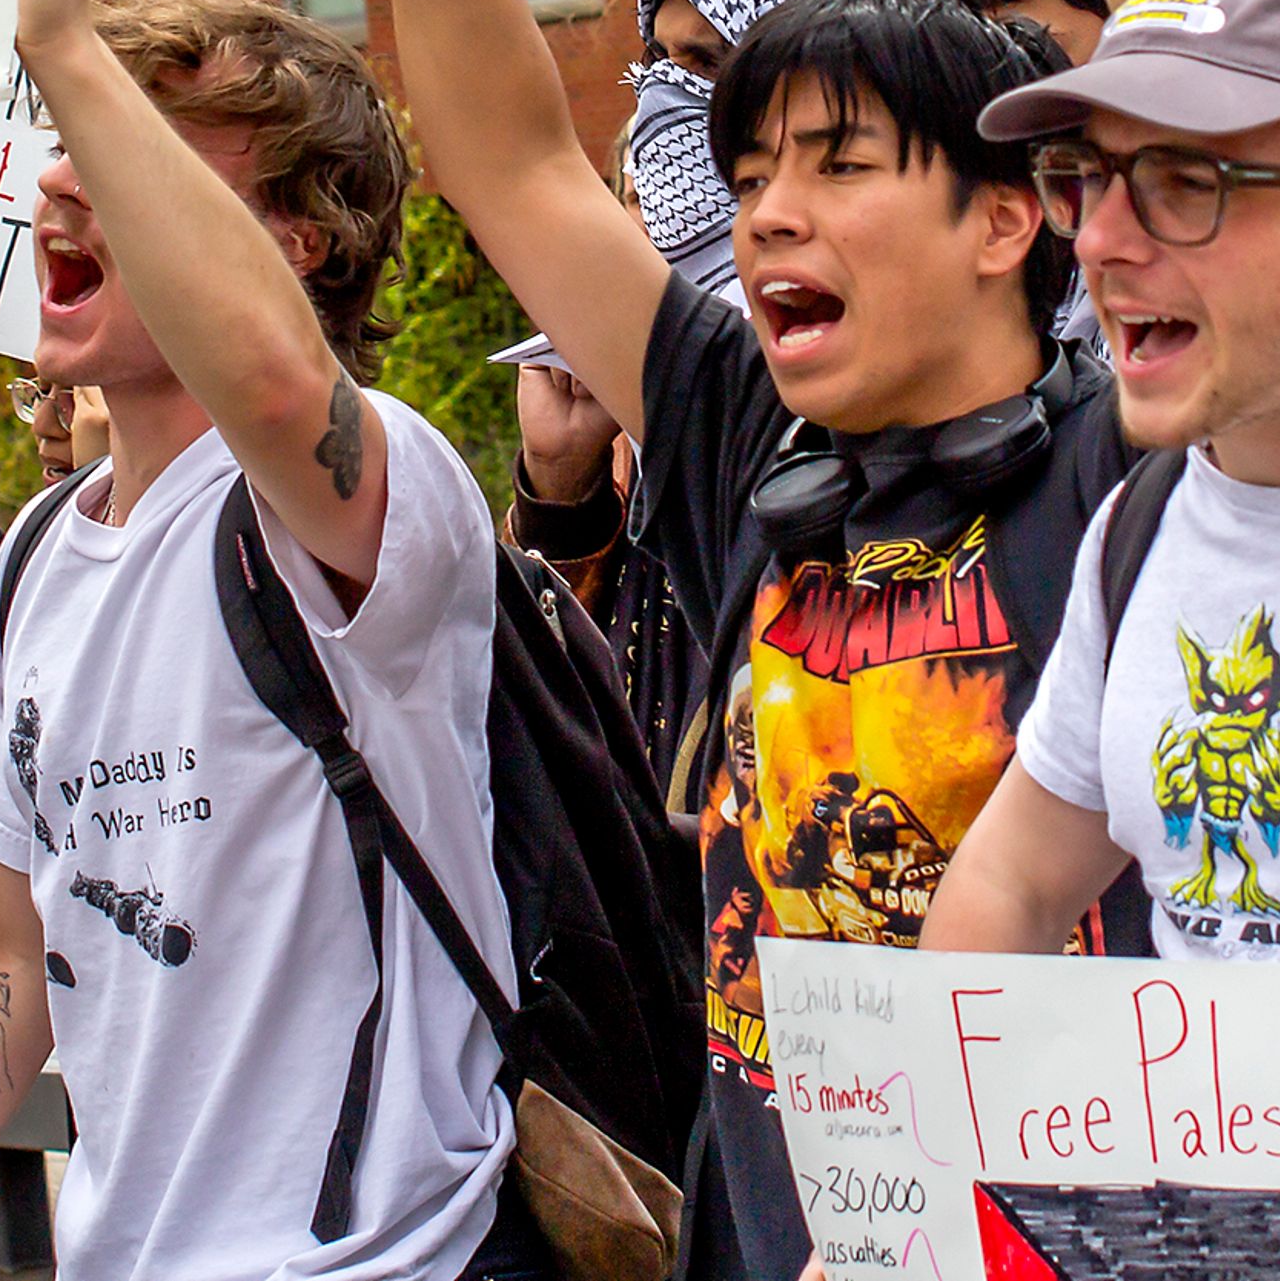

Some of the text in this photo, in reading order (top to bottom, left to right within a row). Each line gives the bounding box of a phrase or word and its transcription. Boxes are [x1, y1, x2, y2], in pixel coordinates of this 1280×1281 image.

[89, 747, 166, 789] Daddy
[91, 808, 144, 839] War
[157, 796, 212, 828] Hero
[791, 976, 842, 1016] child
[787, 1073, 812, 1114] 15
[951, 988, 1115, 1171] Free
